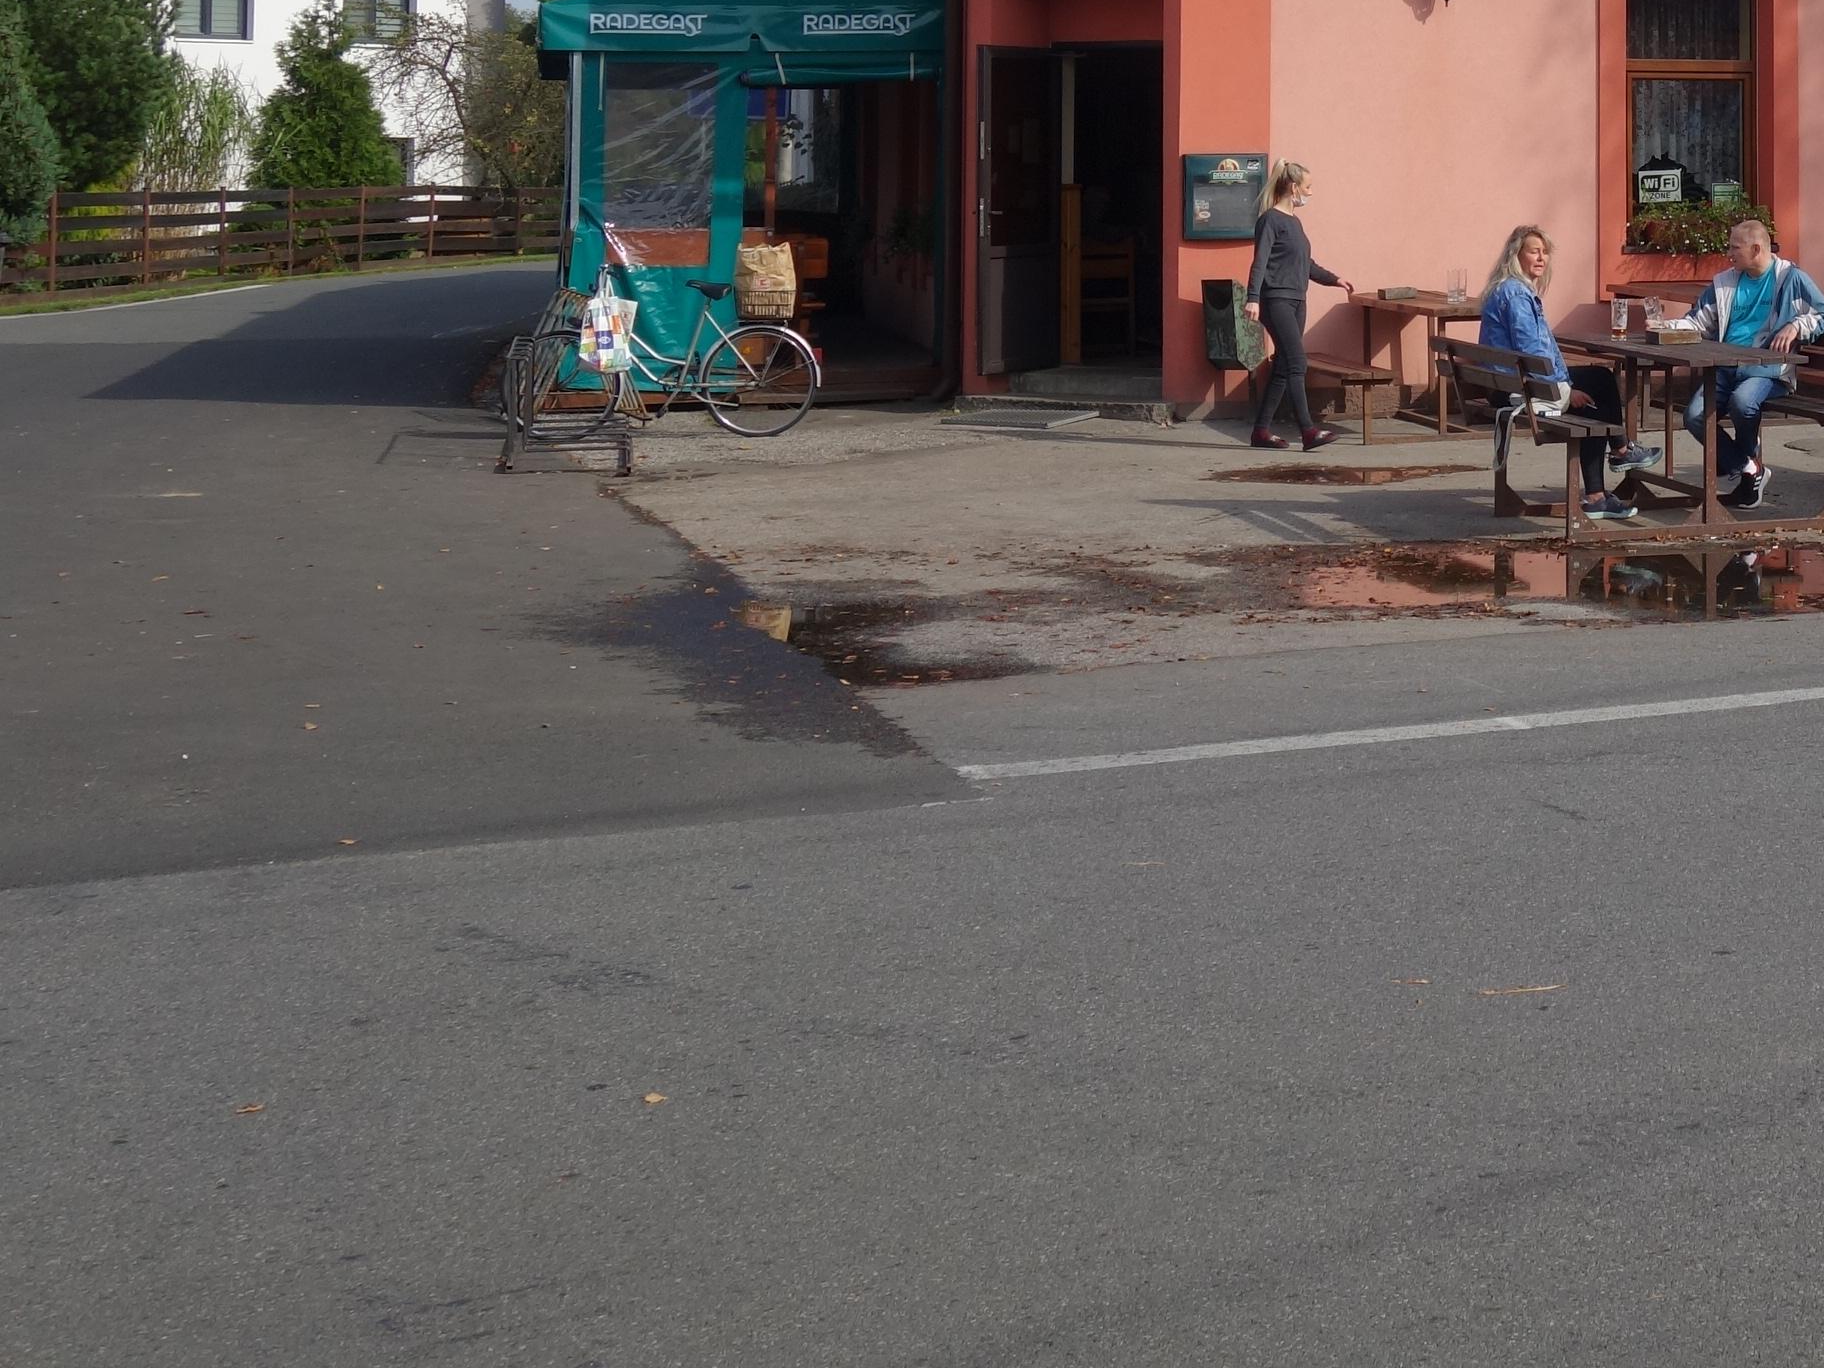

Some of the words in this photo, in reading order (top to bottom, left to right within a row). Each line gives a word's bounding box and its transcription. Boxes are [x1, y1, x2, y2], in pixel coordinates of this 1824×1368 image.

[590, 13, 707, 36] RADEGAST
[803, 14, 916, 36] RADEGAST
[1650, 192, 1671, 200] ZONE
